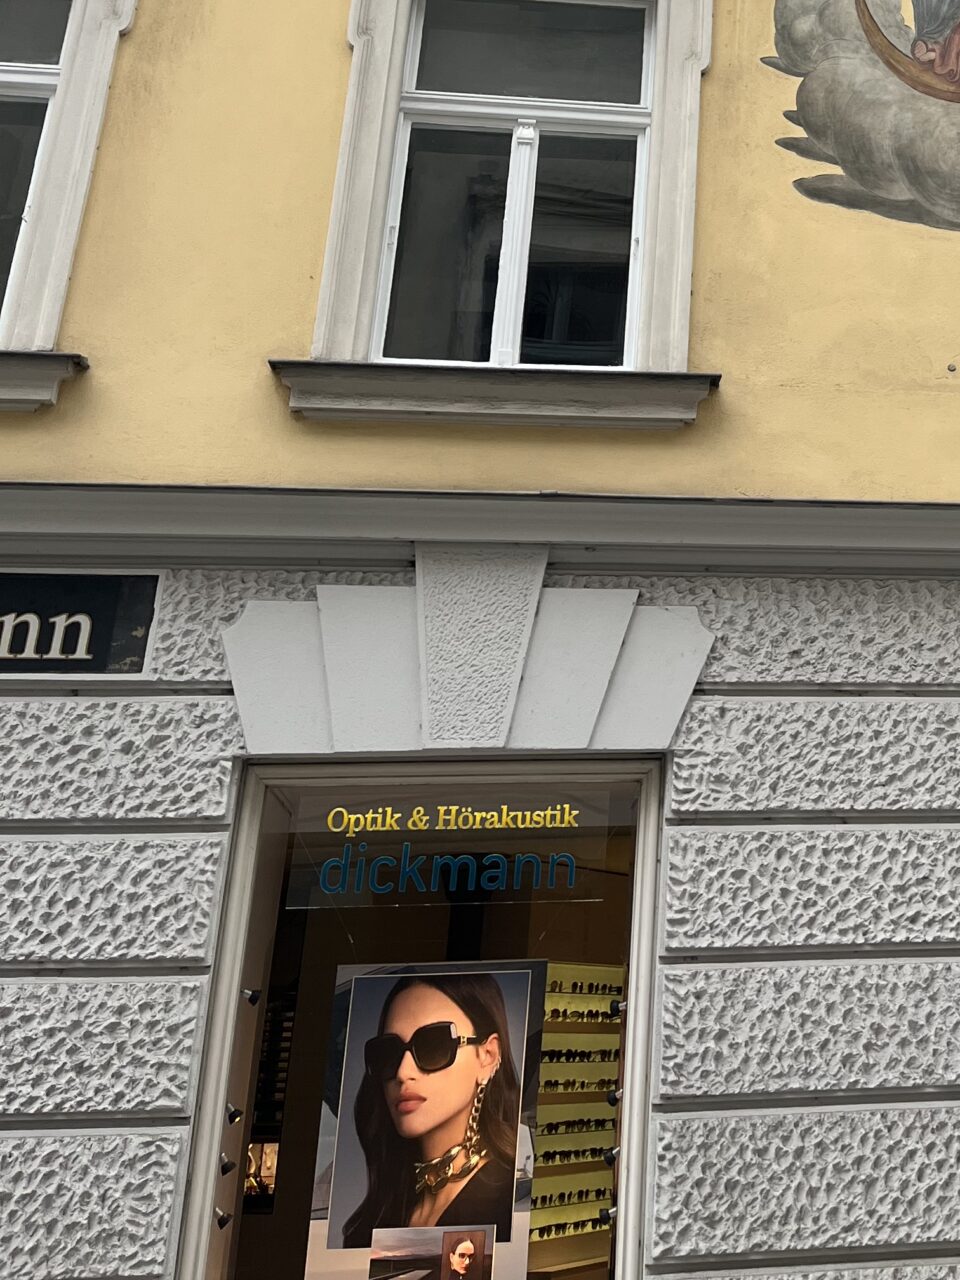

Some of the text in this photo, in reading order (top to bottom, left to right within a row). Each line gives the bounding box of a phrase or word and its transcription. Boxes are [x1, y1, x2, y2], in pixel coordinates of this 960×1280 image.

[327, 804, 579, 837] Optik & Hörakustik
[319, 842, 576, 894] dickmann
